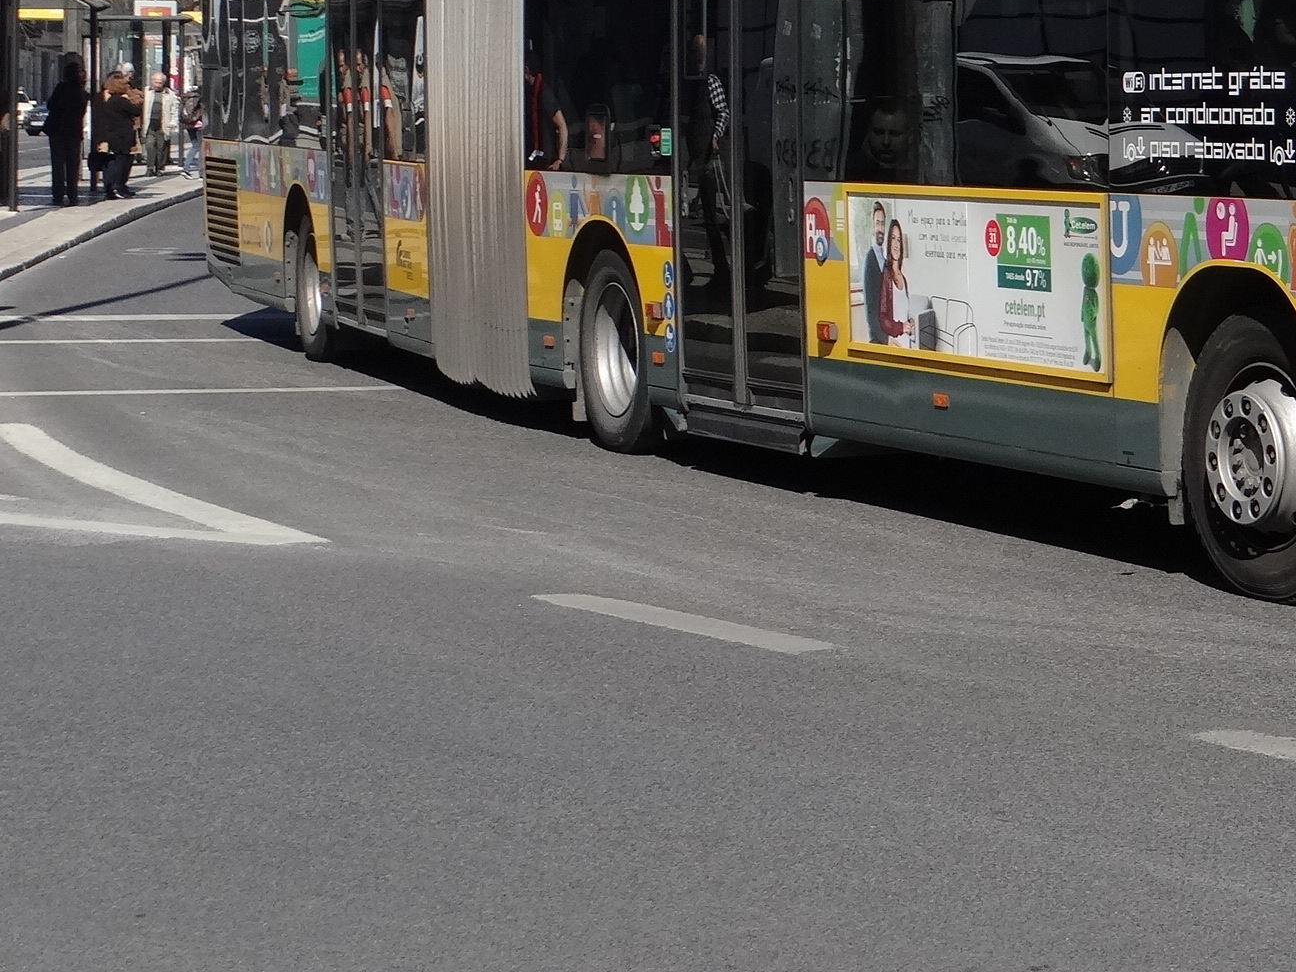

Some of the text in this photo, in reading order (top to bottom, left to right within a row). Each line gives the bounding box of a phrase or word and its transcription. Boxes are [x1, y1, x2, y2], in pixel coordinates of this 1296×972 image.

[1149, 67, 1224, 91] internet
[1228, 65, 1286, 96] grátis
[1140, 102, 1275, 126] ar condicionado
[1150, 136, 1265, 163] piso rebaixado
[988, 232, 997, 244] 31
[1006, 225, 1046, 259] 8,40%
[1025, 268, 1047, 289] 9,7%
[1004, 298, 1046, 322] cetelem.pt
